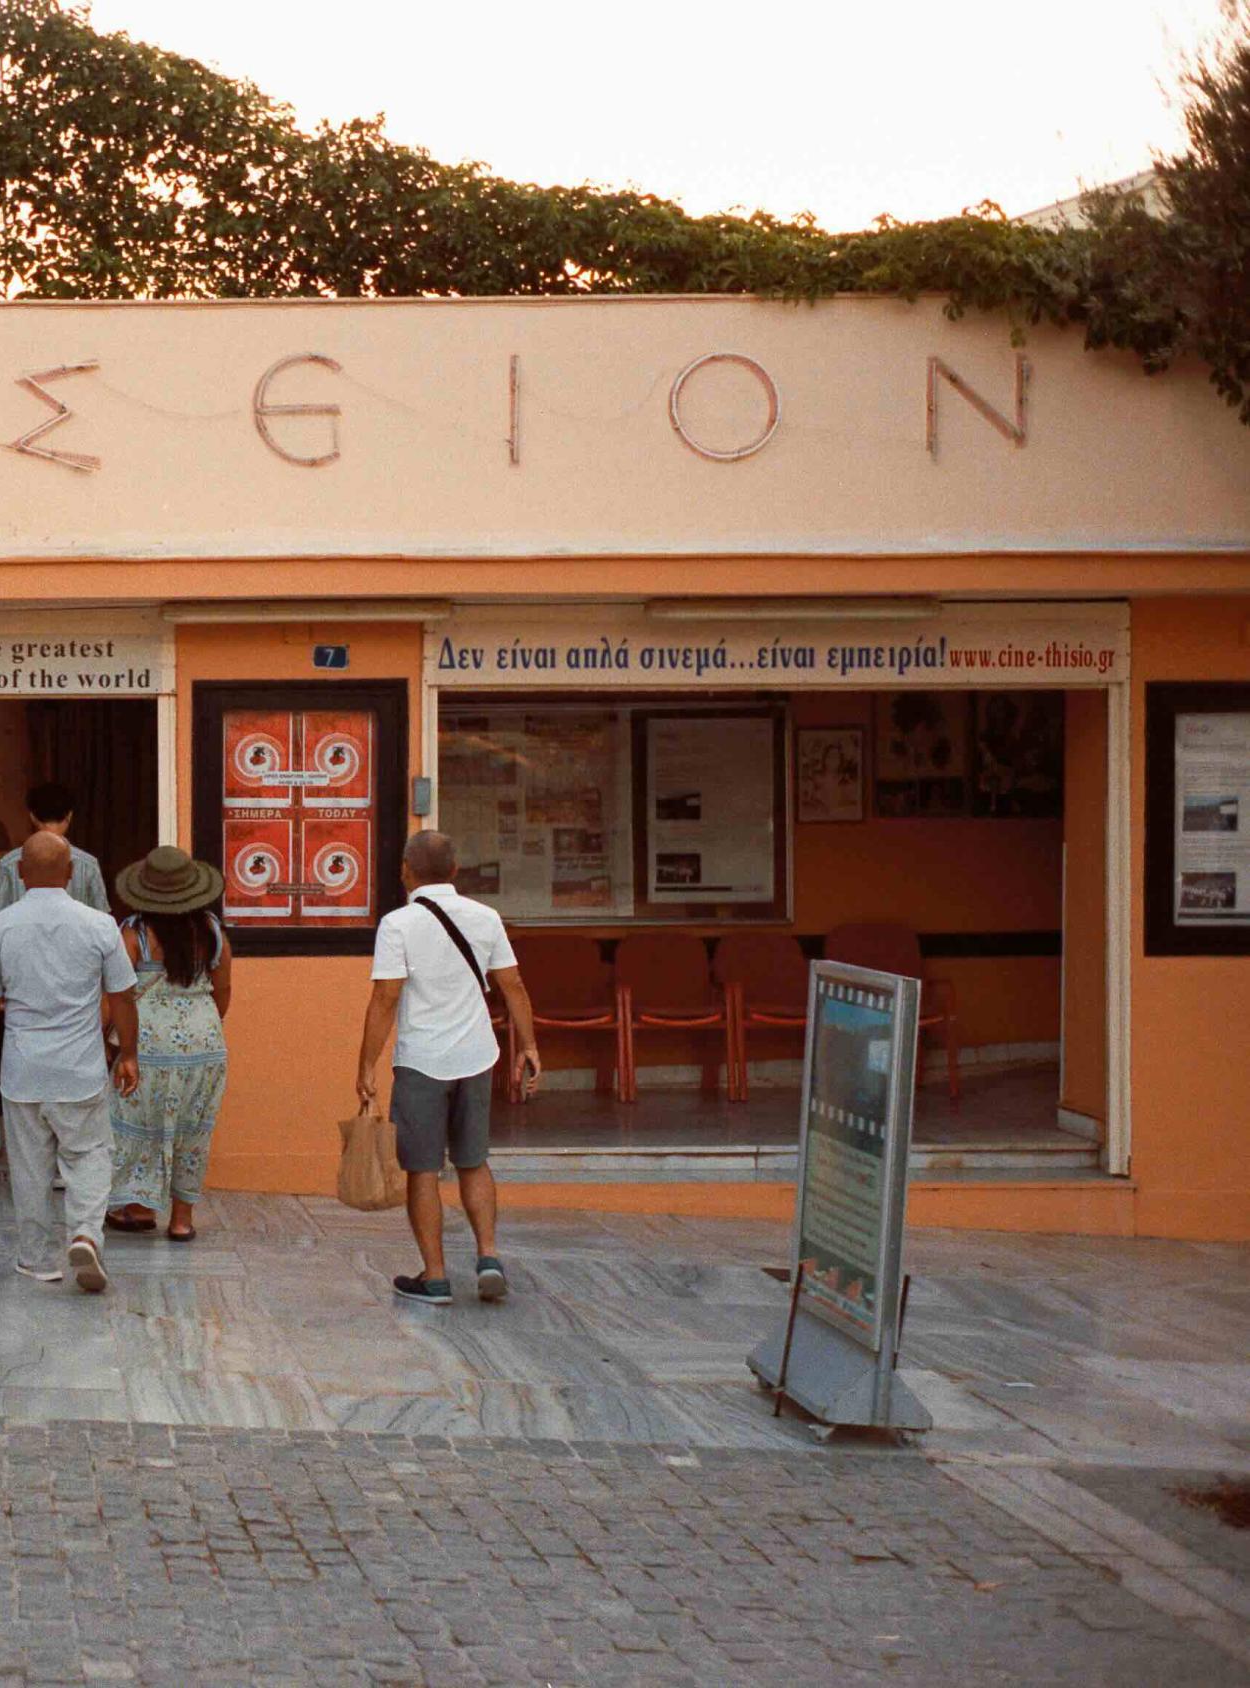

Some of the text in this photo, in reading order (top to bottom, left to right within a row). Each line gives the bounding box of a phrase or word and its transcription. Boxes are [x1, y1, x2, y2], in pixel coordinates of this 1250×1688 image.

[11, 639, 115, 663] greatest
[324, 648, 335, 667] 7
[437, 637, 484, 670] Δεν
[495, 638, 557, 670] είναι
[566, 637, 630, 670] απλά
[826, 635, 947, 676] εμπειρία!
[950, 640, 1116, 674] www.cine-thisio.gr
[29, 669, 69, 689] the
[77, 668, 151, 689] world
[233, 808, 282, 819] ΣΗΜΕΡΑ
[318, 808, 357, 819] TODAY
